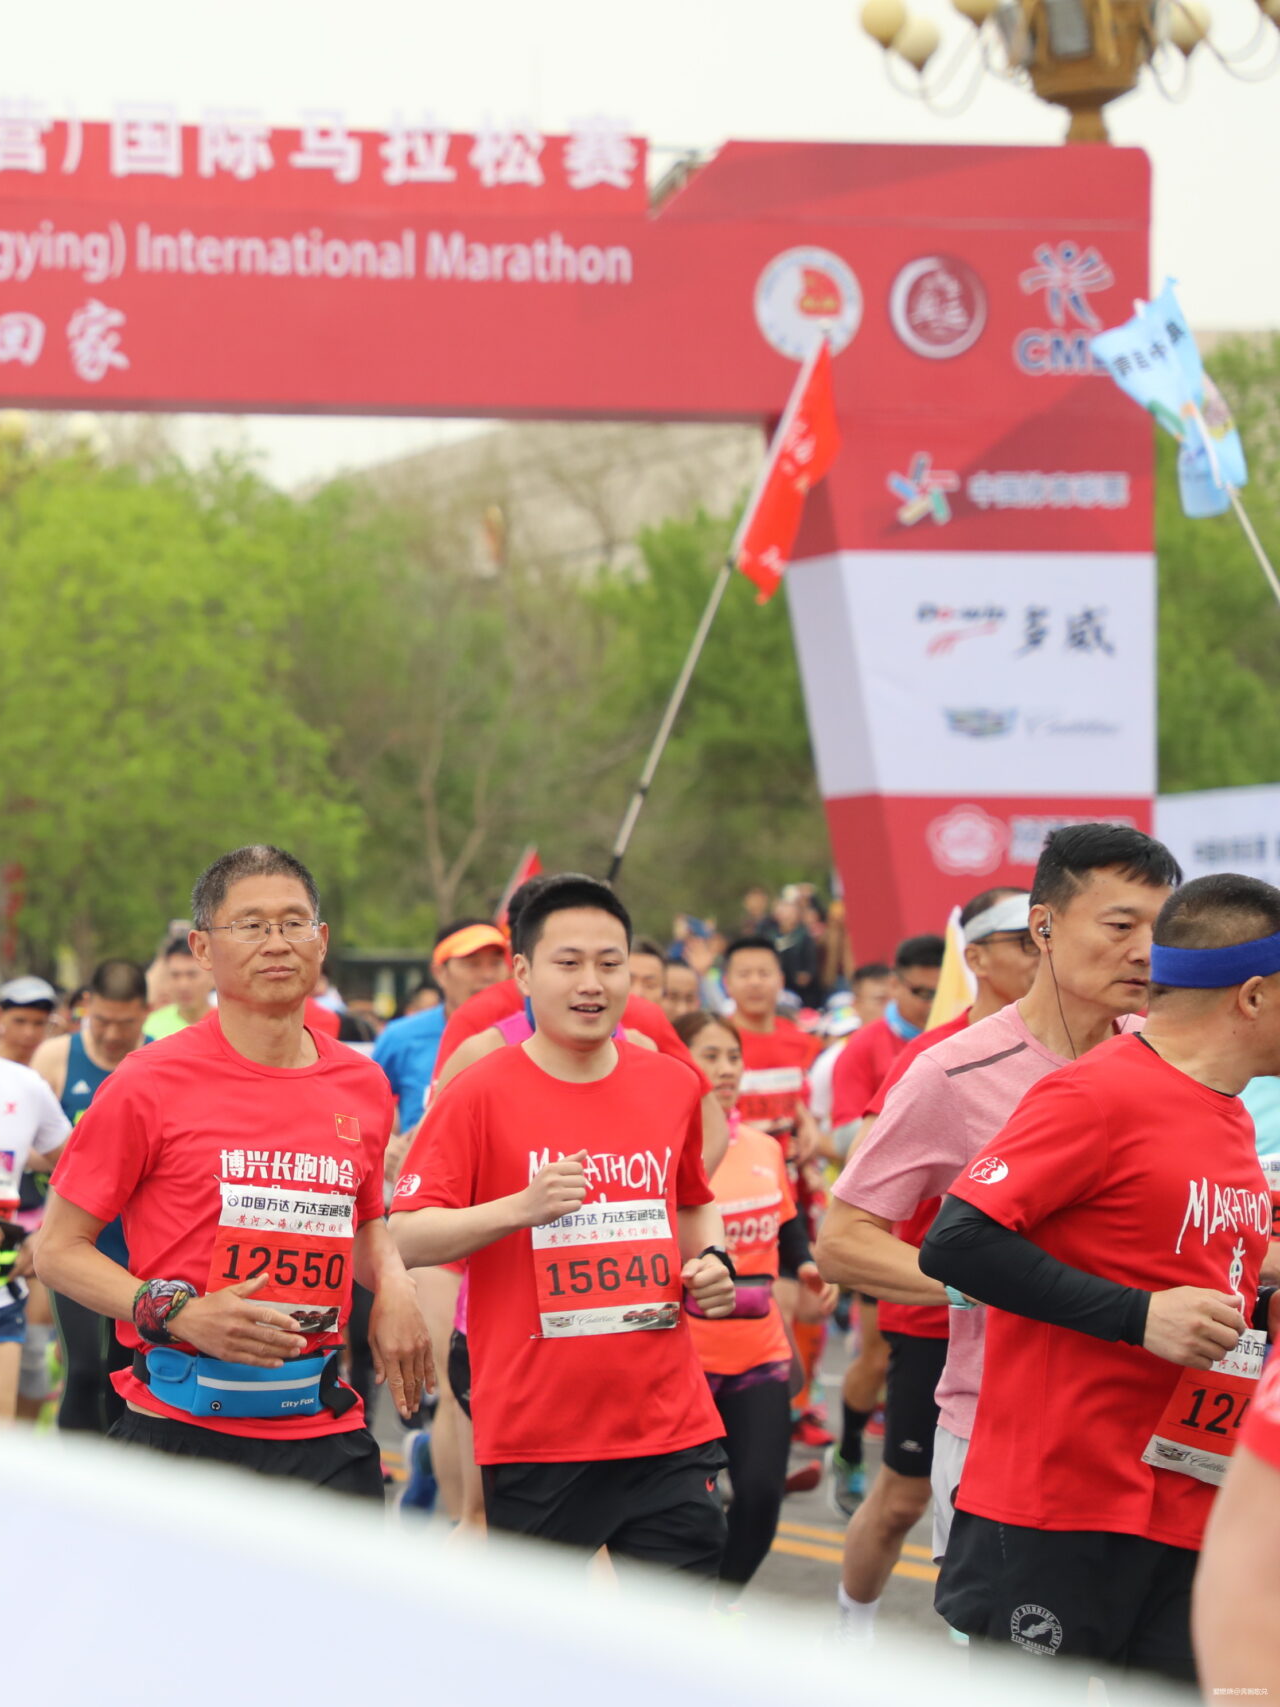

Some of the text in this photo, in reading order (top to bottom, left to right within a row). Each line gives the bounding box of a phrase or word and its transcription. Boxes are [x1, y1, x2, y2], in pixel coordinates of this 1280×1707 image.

[136, 222, 416, 280] International
[426, 230, 633, 284] Marathon
[220, 1149, 354, 1188] 博兴长跑协会
[529, 1146, 671, 1195] MATHON
[241, 1195, 290, 1213] 中国万达
[222, 1244, 345, 1289] 12550
[546, 1253, 670, 1296] 15640
